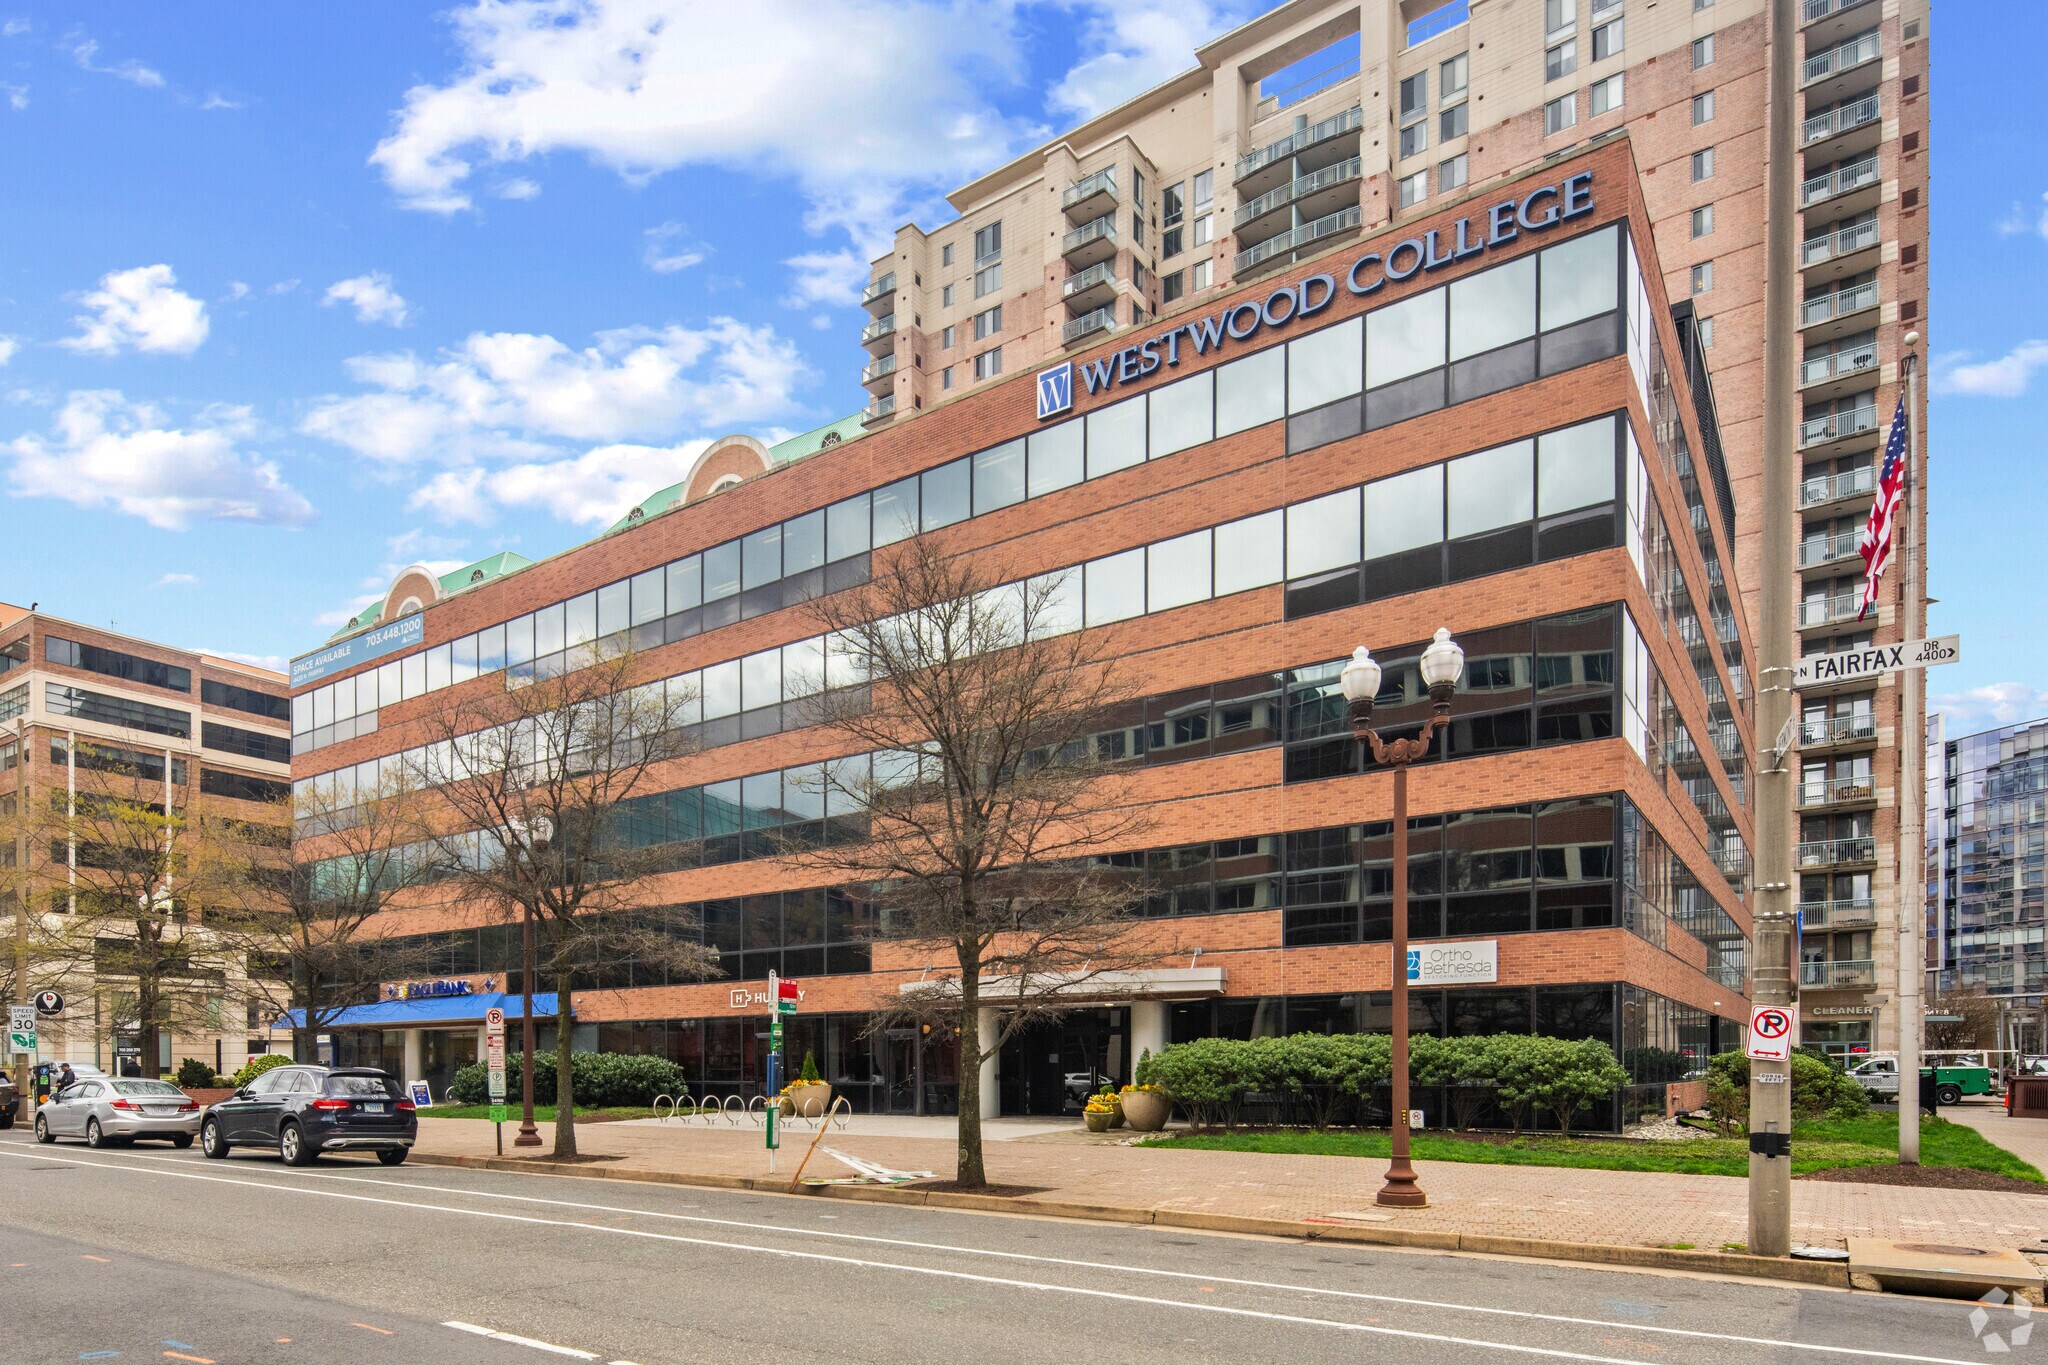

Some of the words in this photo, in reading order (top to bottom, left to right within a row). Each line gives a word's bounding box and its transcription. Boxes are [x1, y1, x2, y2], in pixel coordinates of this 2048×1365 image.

[1079, 273, 1336, 395] WESTWOOD
[1346, 169, 1595, 296] COLLEGE
[1039, 371, 1068, 415] W
[366, 618, 420, 648] 703.448.1200
[1924, 641, 1939, 652] DR
[293, 660, 314, 675] SPACE
[314, 645, 352, 667] AVAILABLE
[1800, 667, 1808, 677] N
[1815, 646, 1904, 679] FAIRFAX
[1915, 649, 1947, 662] 4400
[1424, 960, 1492, 975] Bethesda
[1431, 949, 1472, 962] Ortho
[13, 1019, 34, 1030] 30
